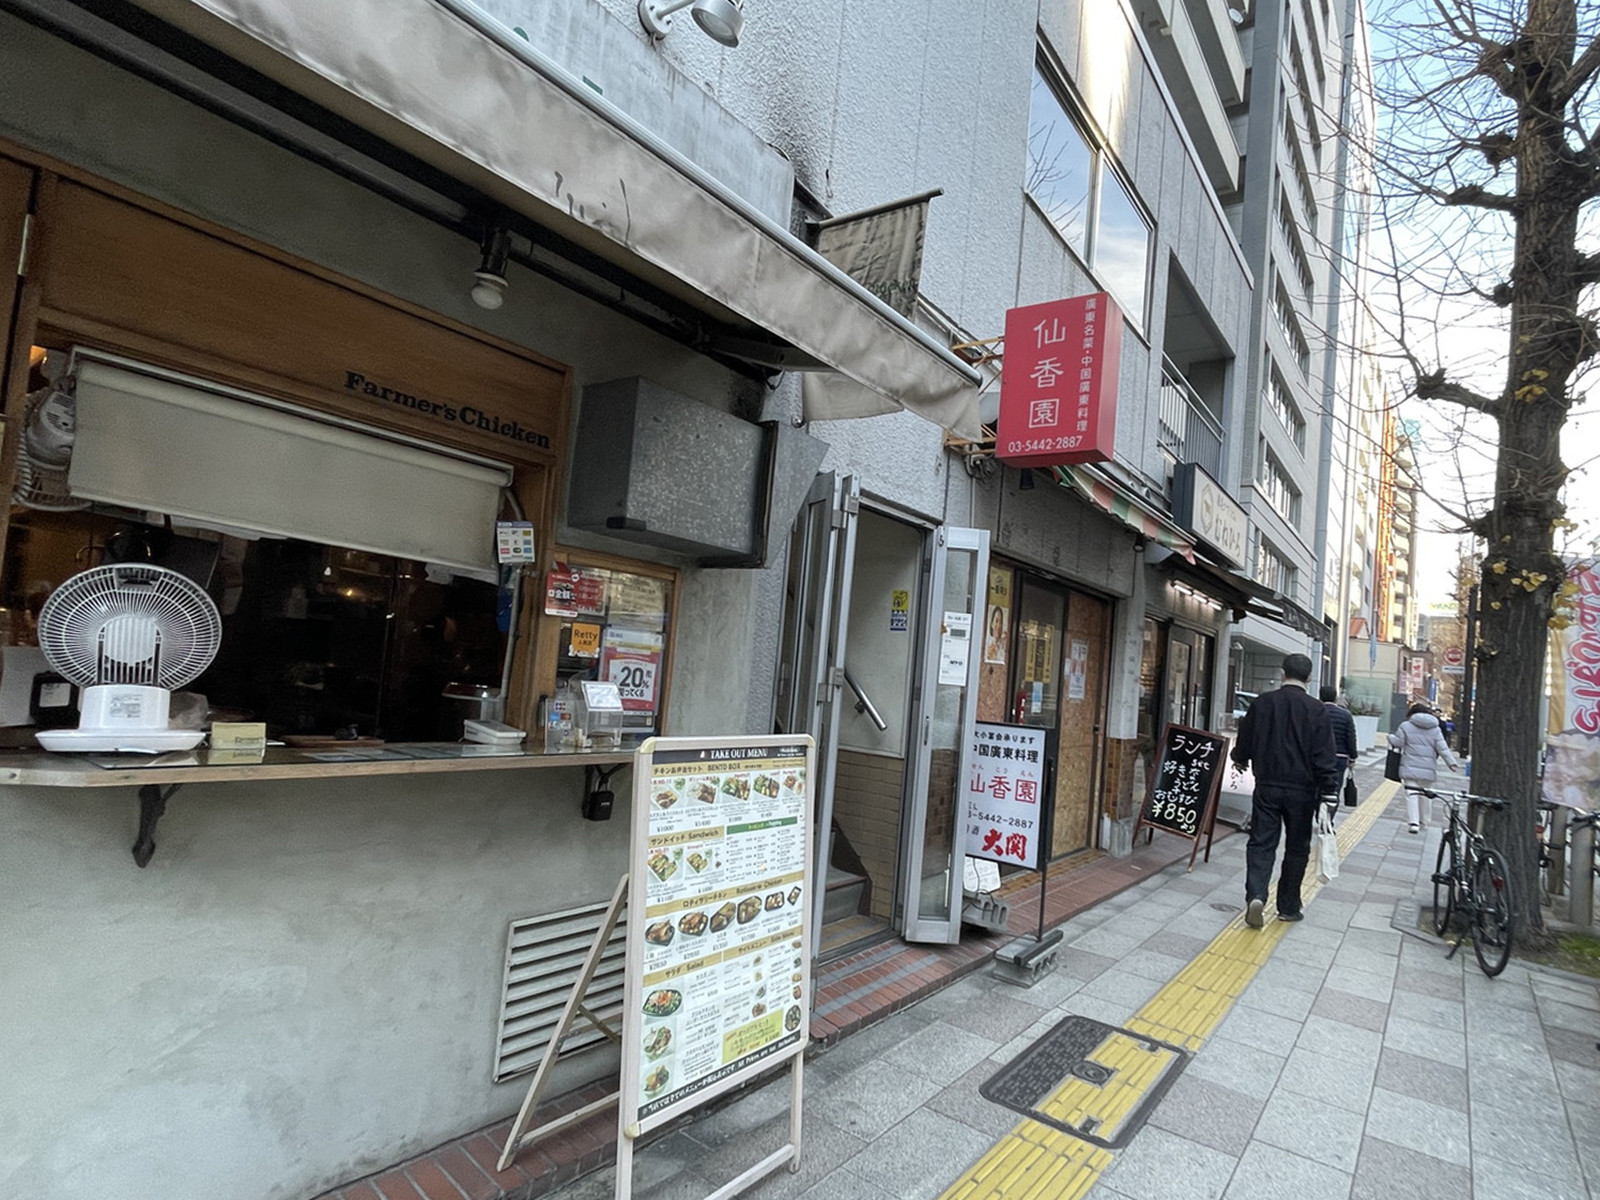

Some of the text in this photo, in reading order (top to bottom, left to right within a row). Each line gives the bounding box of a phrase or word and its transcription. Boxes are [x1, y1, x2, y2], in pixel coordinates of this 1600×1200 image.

[1028, 318, 1066, 428] 仙香園
[344, 371, 550, 449] Farmer's Chicken
[1008, 435, 1083, 453] 03-5442-2887
[574, 630, 598, 641] Retty
[710, 748, 768, 759] TAKE OUT MENU
[1172, 734, 1214, 758] ランチ
[1154, 789, 1198, 805] おむすび
[968, 810, 1034, 828] 3-5442-2887
[1152, 799, 1196, 824] ¥850
[650, 830, 719, 846] サンドイッチ Sandwich
[966, 824, 1027, 861] 酒 大関
[686, 960, 704, 971] Salad
